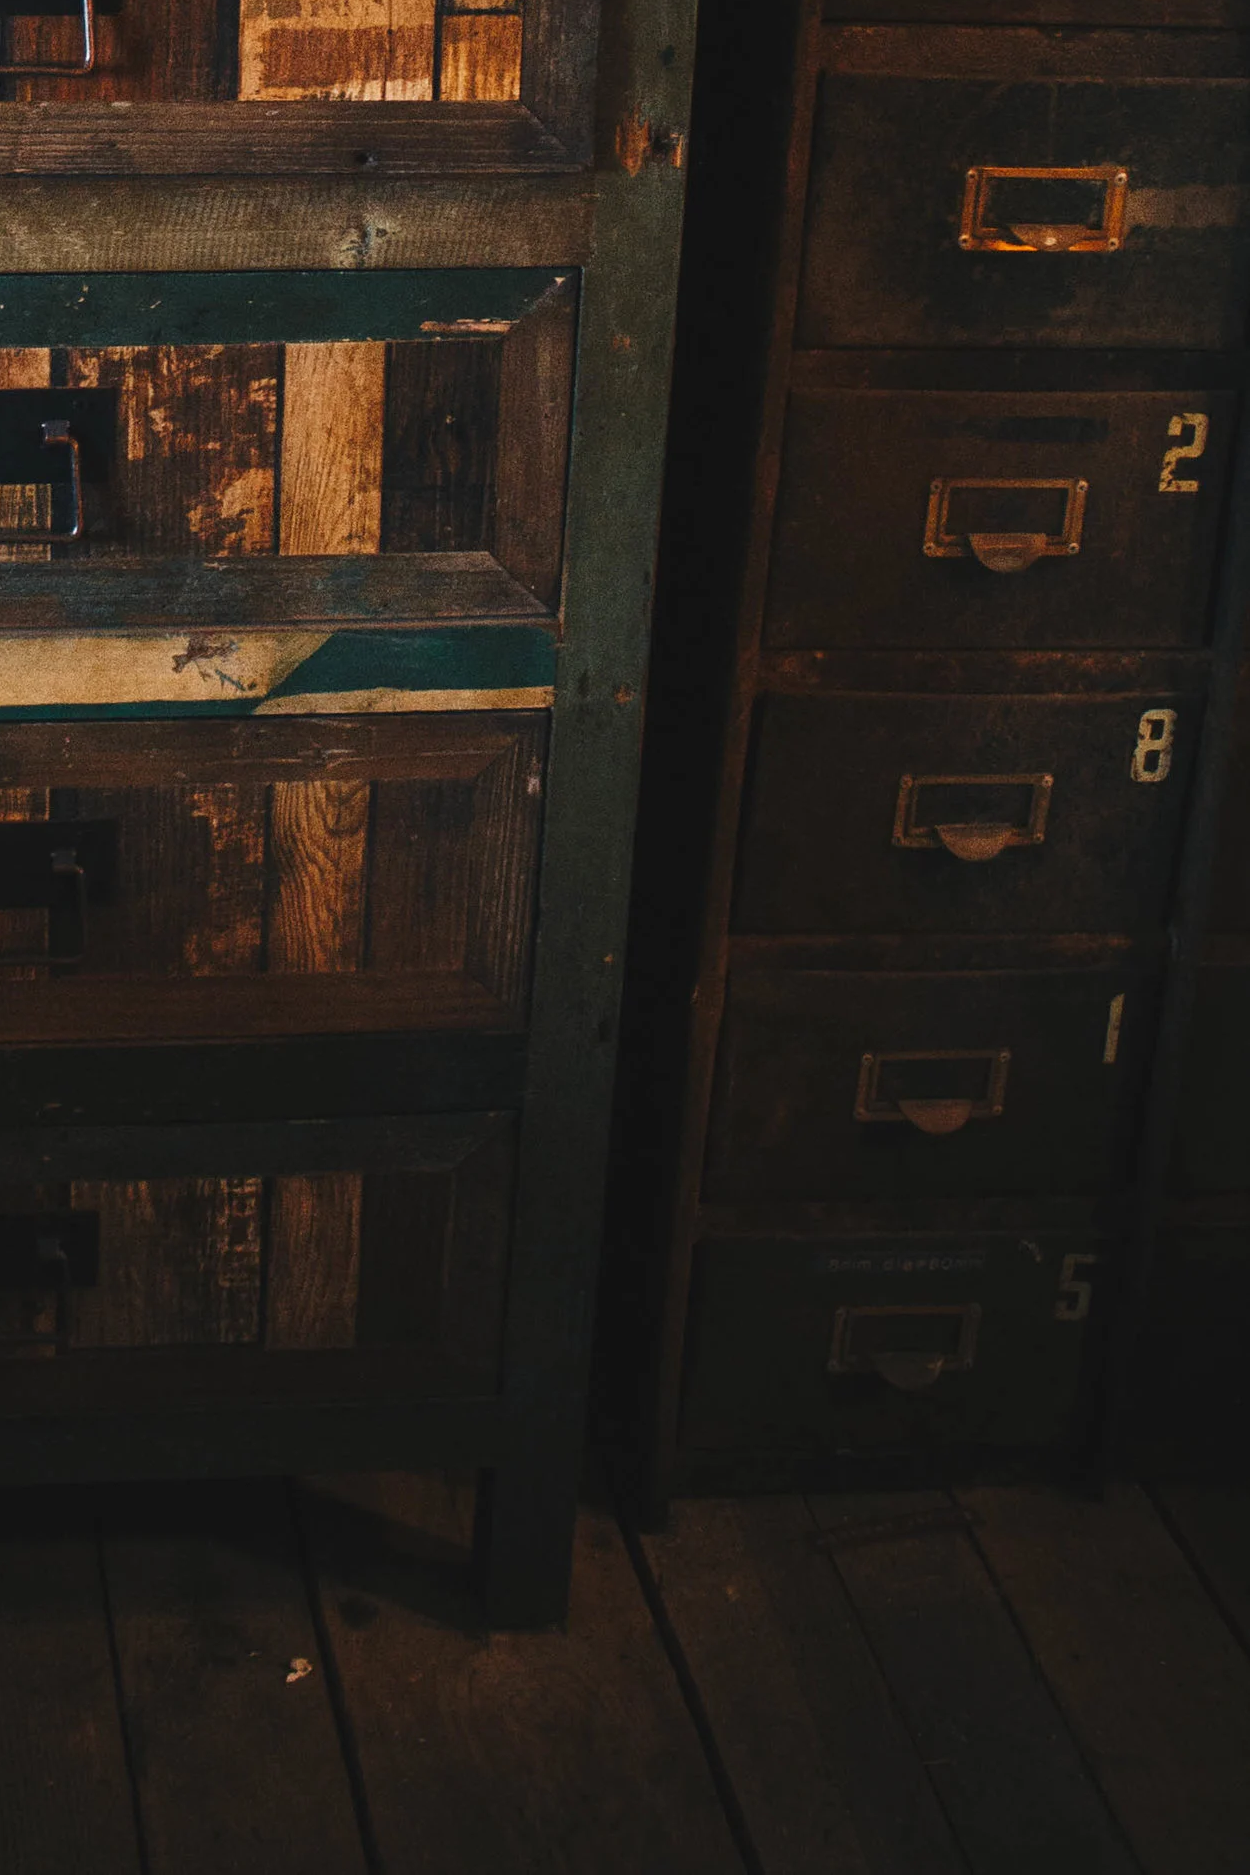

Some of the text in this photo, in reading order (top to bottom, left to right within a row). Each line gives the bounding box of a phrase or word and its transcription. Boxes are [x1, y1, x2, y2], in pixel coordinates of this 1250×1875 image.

[1158, 412, 1209, 493] 2
[1130, 708, 1177, 783] 8
[1102, 992, 1126, 1063] 1
[1053, 1253, 1097, 1321] 5
